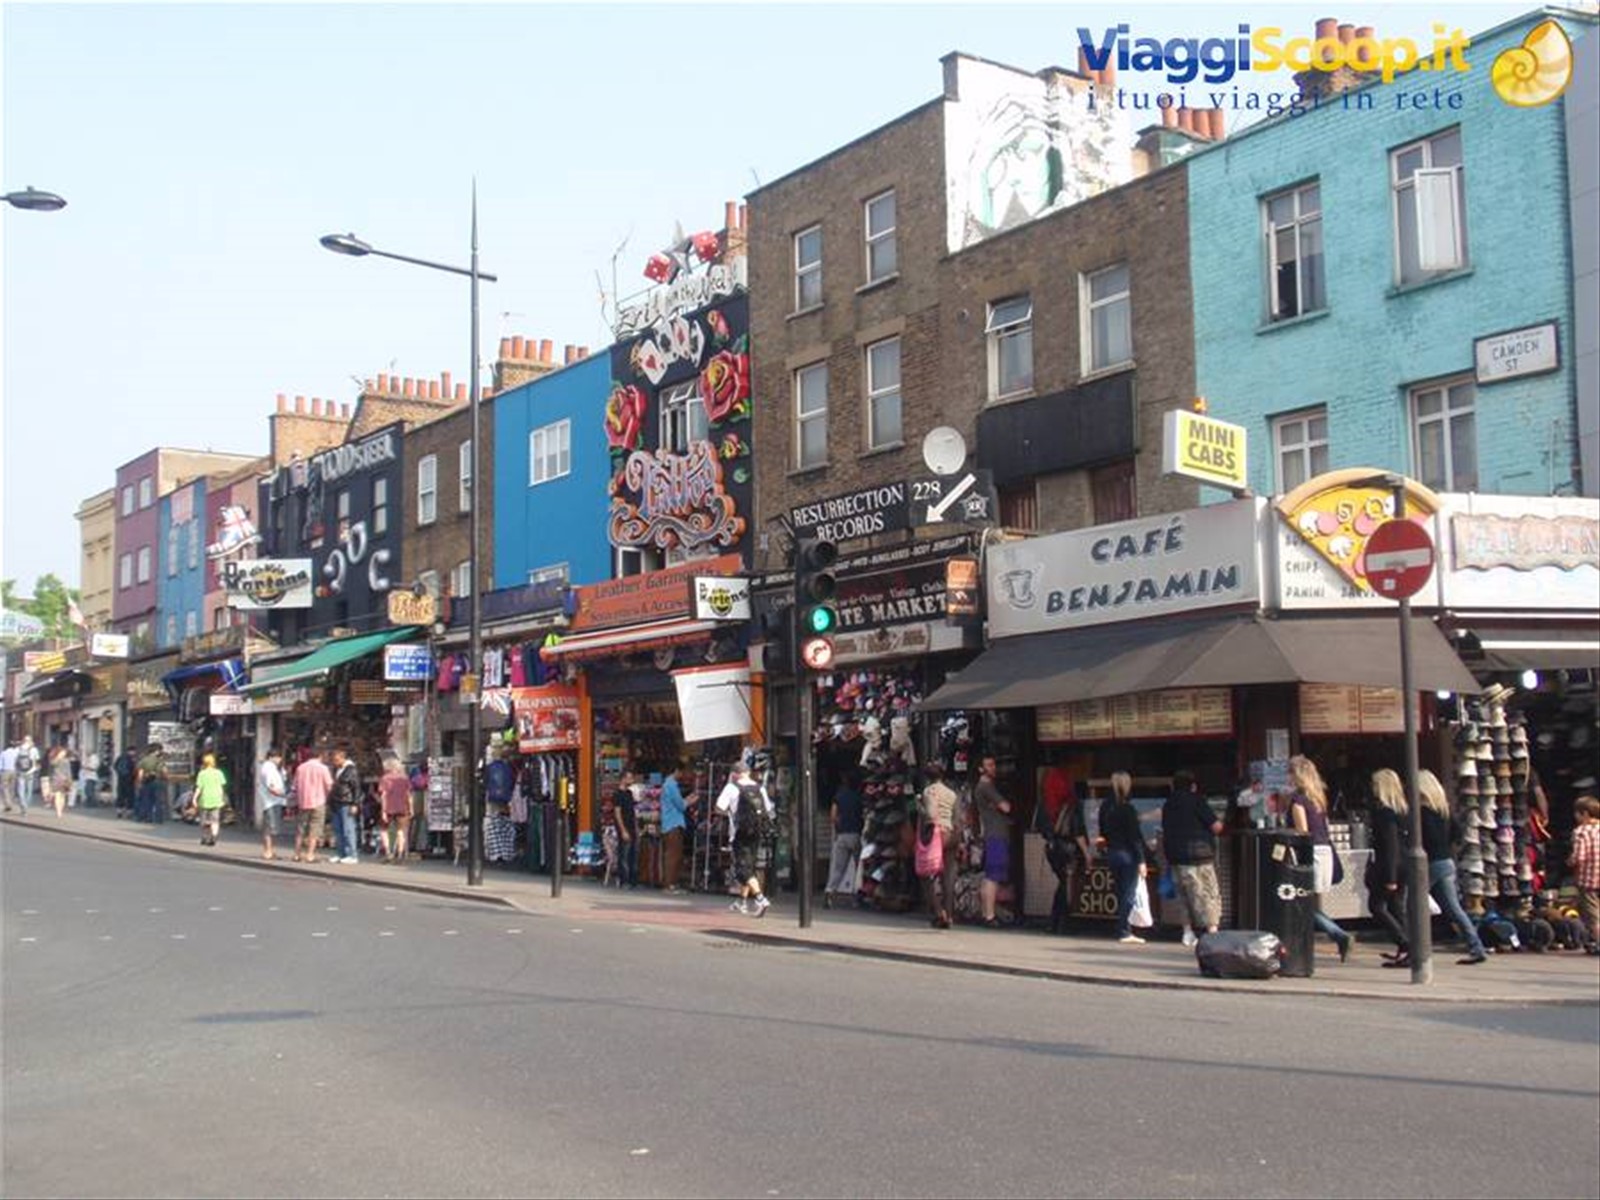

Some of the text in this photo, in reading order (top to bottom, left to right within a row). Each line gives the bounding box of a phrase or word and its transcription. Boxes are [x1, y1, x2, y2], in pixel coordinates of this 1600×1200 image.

[1491, 340, 1539, 360] CAMDEN
[1505, 358, 1518, 371] ST
[1189, 420, 1235, 449] MINI
[1188, 441, 1236, 470] CABS
[912, 480, 942, 501] 228
[792, 483, 904, 528] RESURRECTION
[816, 512, 884, 542] RECORDS
[1090, 516, 1183, 563] CAFÉ
[1286, 560, 1318, 573] CHIPS
[1045, 565, 1239, 614] BENJAMIN
[1286, 585, 1325, 598] PANINI
[871, 593, 947, 623] MARKET
